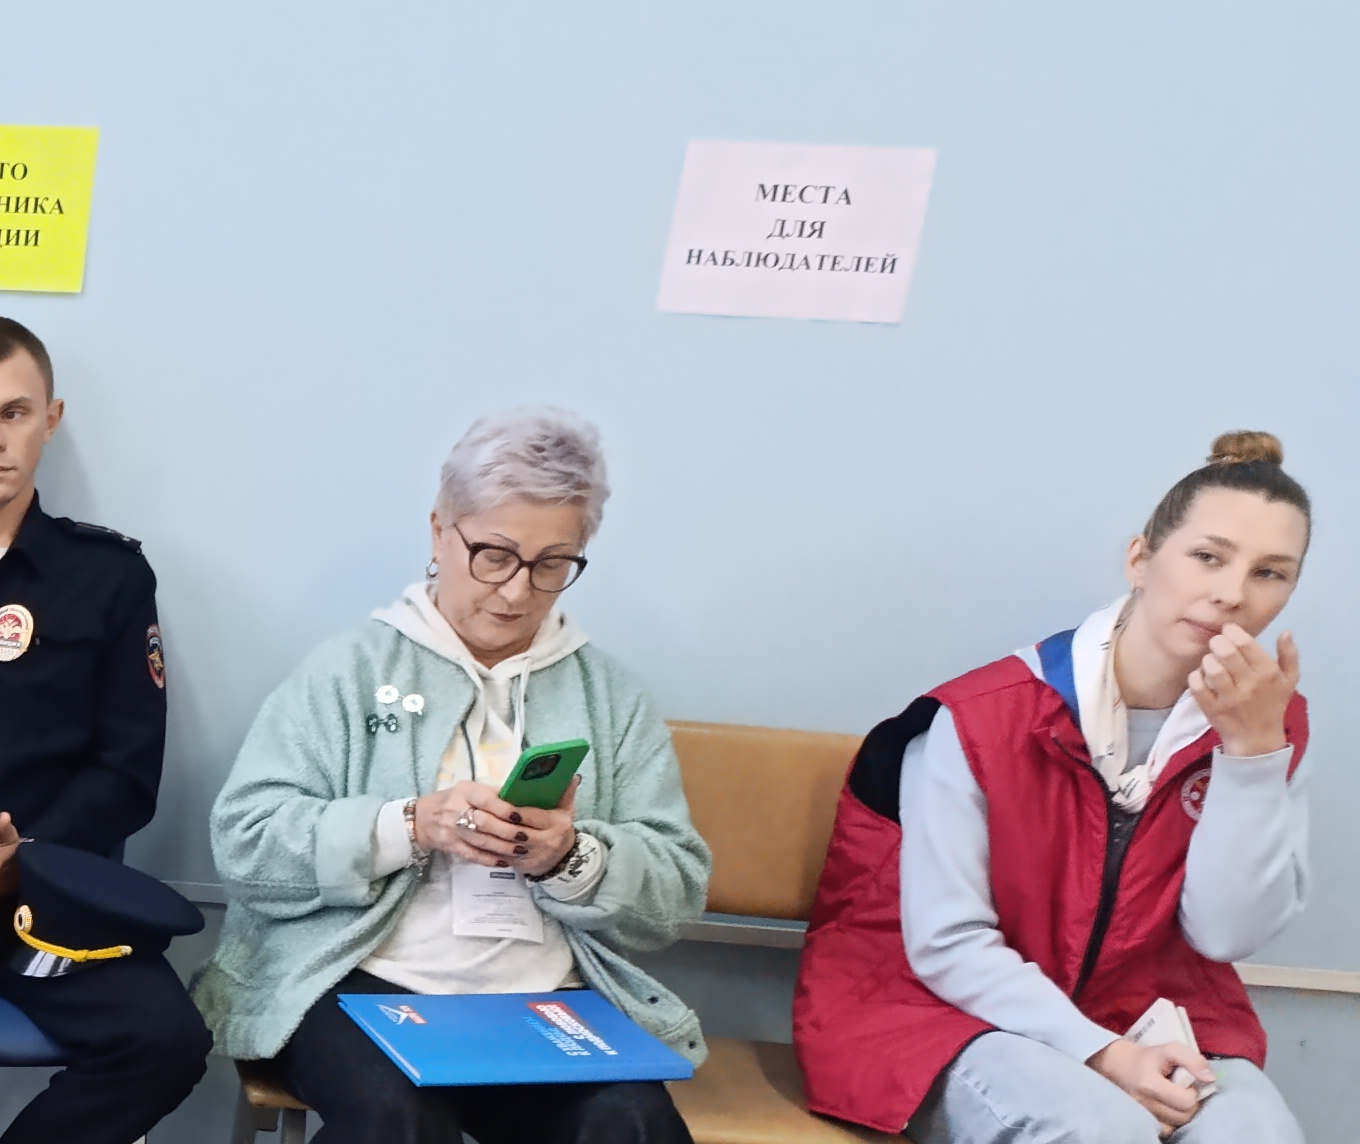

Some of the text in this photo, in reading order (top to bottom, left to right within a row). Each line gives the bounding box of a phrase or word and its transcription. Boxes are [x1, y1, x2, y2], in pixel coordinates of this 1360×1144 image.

[755, 183, 852, 206] МЕСТА
[766, 218, 827, 241] ДЛЯ
[685, 248, 900, 274] НАБЛЮДАТЕЛЕЙ
